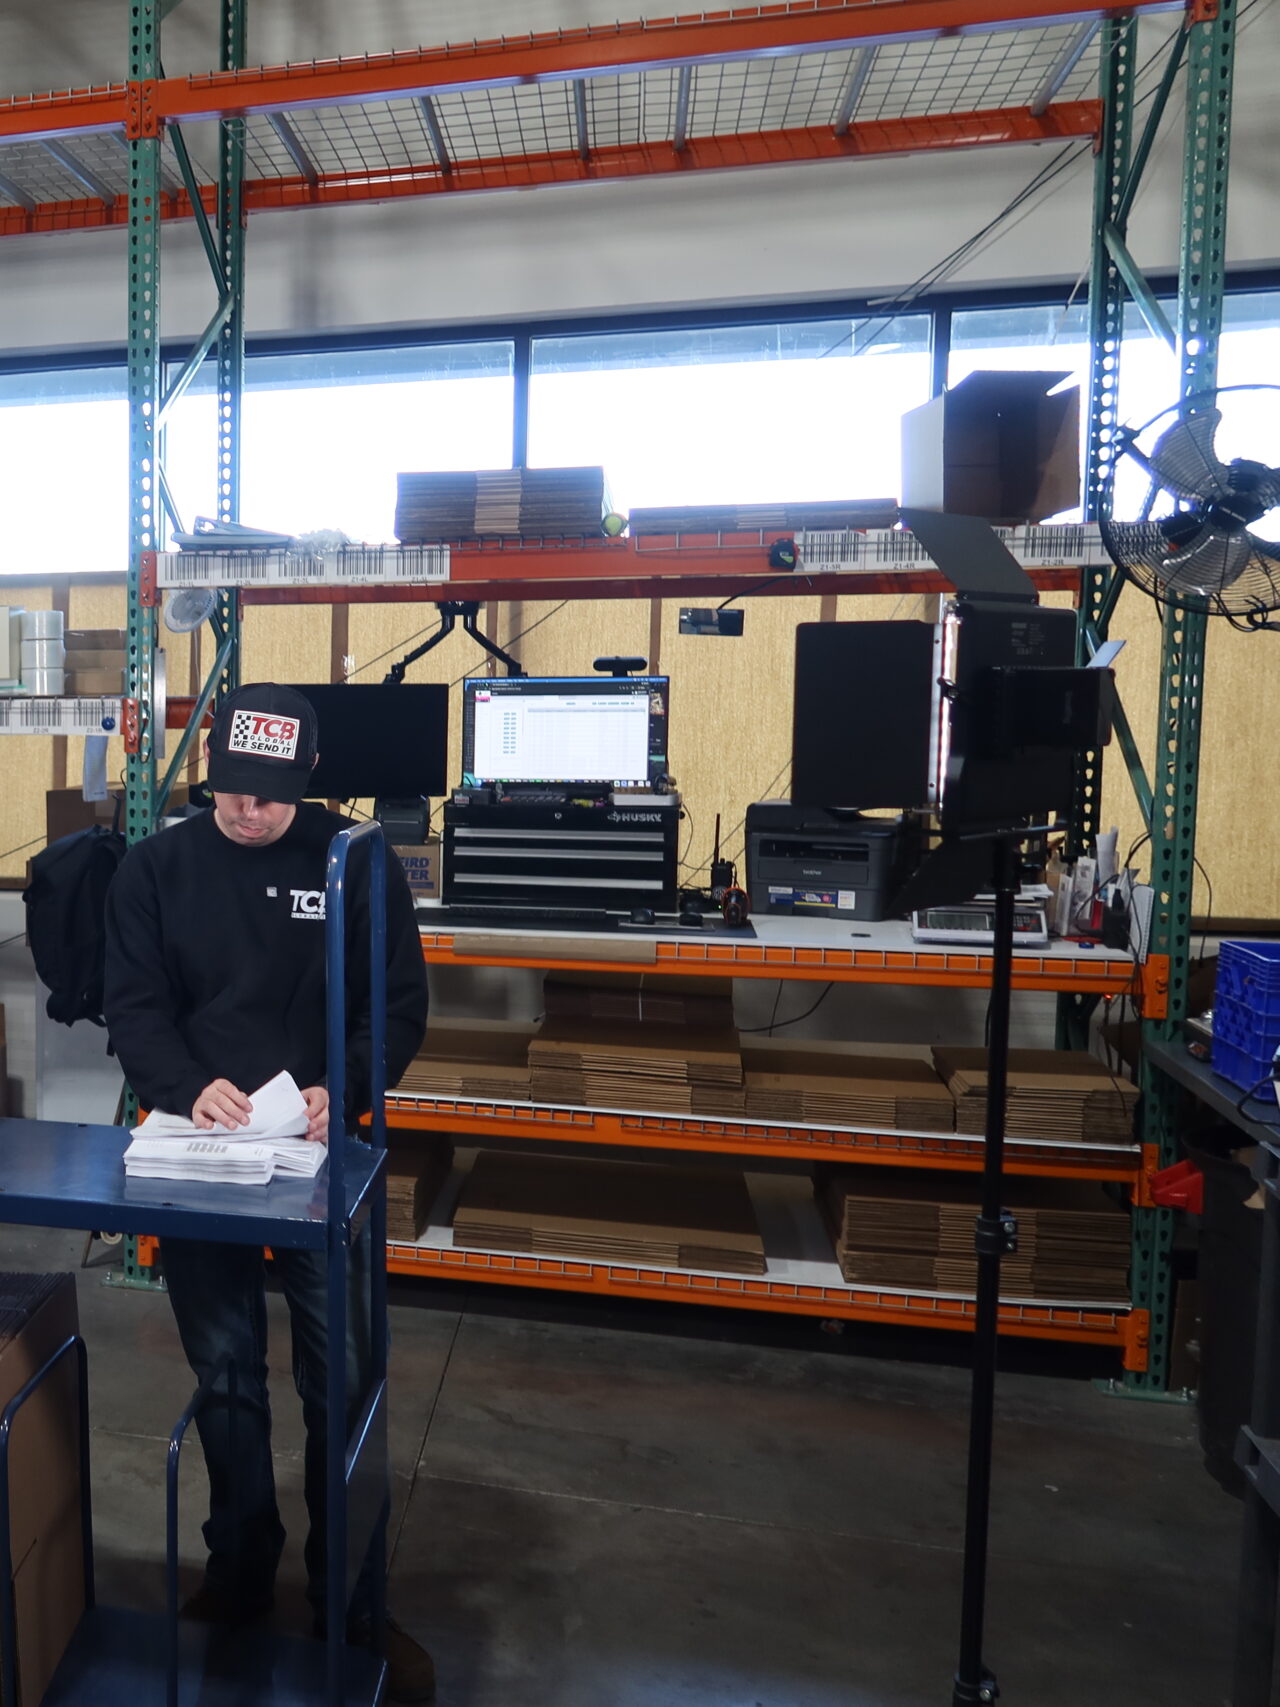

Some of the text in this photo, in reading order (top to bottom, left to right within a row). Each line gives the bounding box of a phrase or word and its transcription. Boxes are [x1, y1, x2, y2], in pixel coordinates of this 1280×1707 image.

[252, 716, 296, 742] TCB
[250, 735, 291, 746] GLOBAL
[233, 740, 291, 755] WE SEND IT
[621, 813, 662, 823] HUSKY
